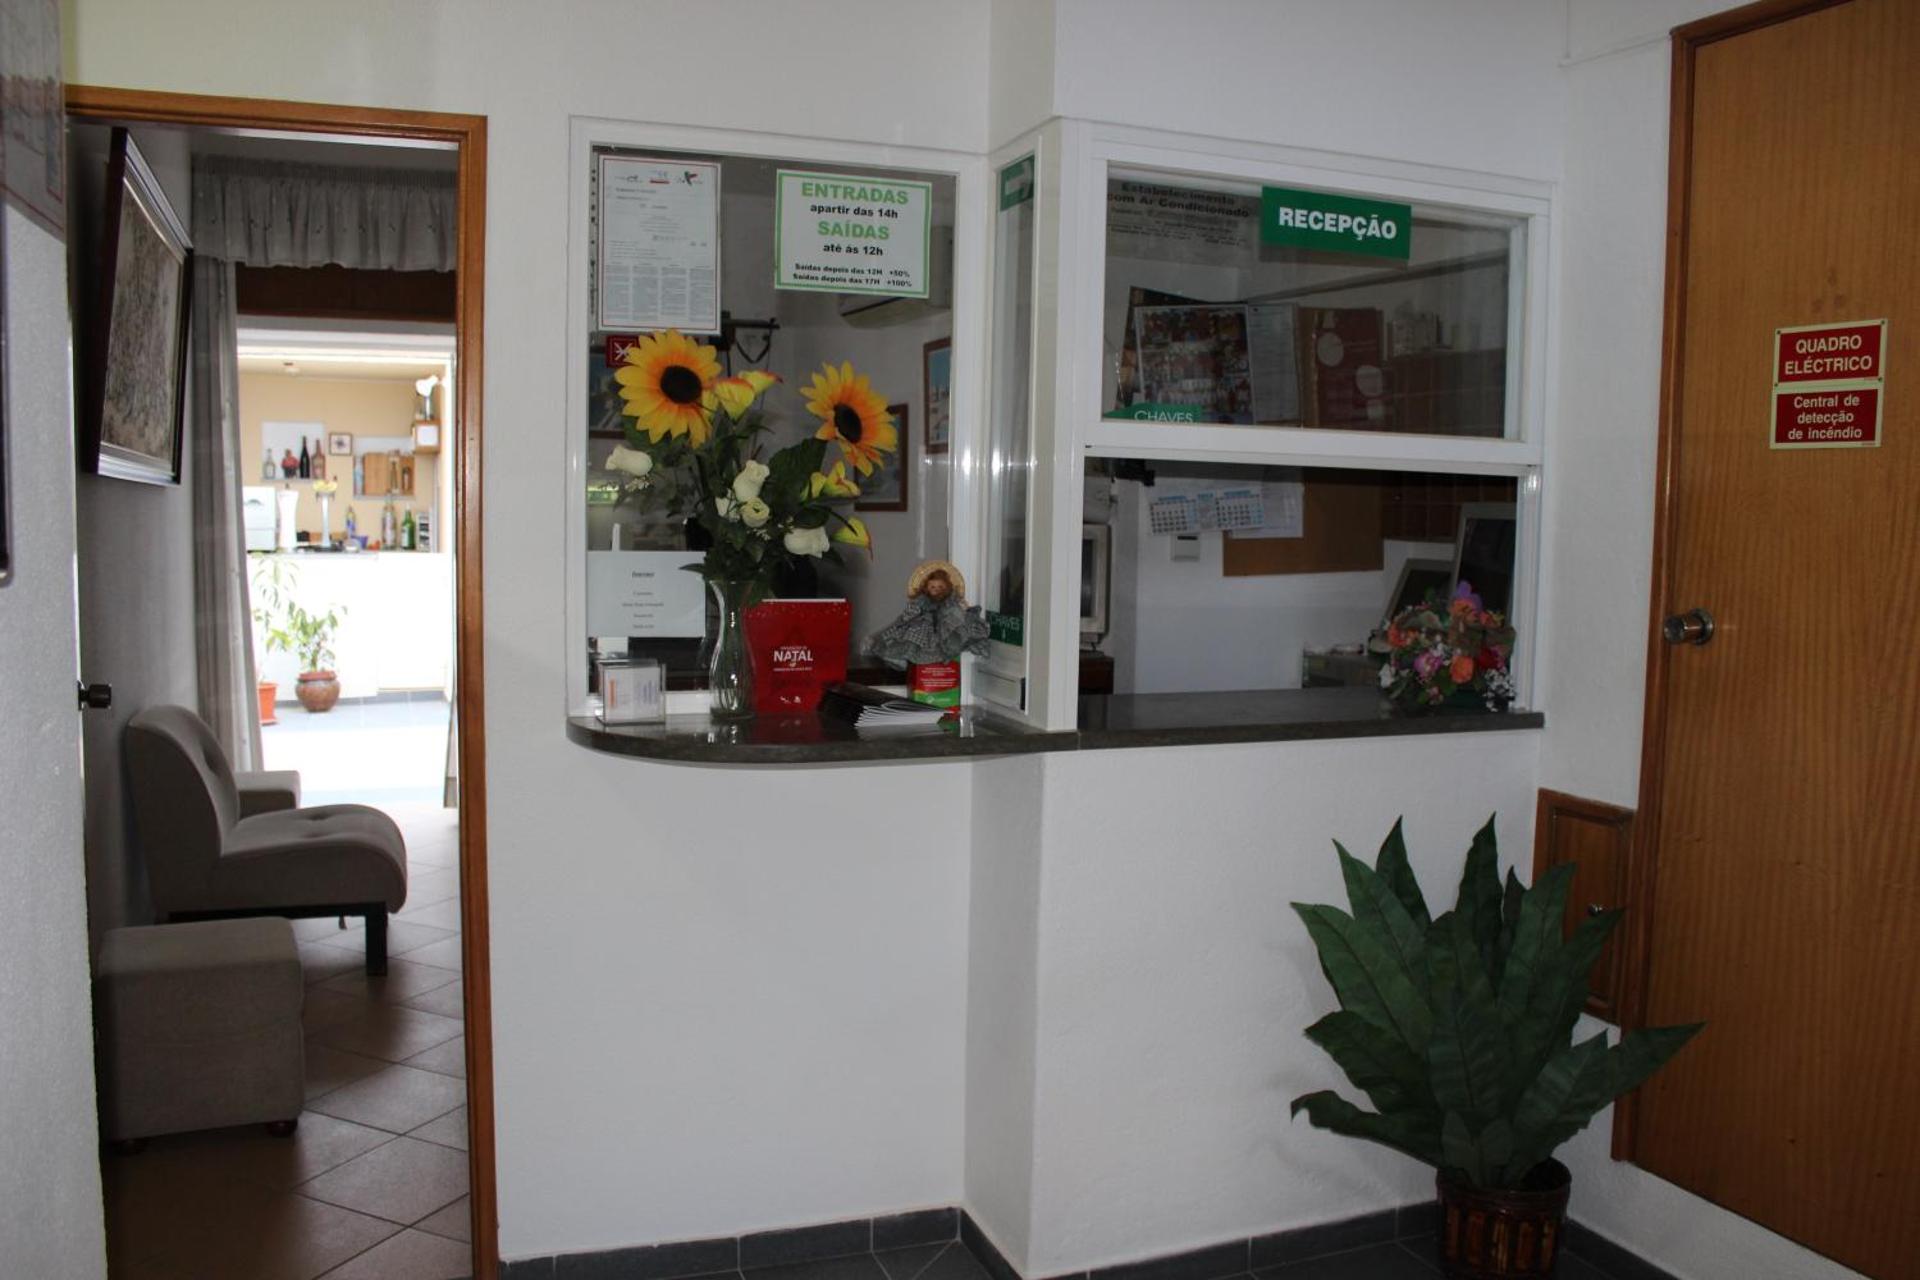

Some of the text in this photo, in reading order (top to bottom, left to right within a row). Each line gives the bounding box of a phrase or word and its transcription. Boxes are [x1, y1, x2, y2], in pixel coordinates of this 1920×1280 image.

[802, 183, 909, 205] ENTRADAS
[1121, 181, 1235, 206] Estabelecimento
[810, 203, 899, 219] apartir das 14h
[1140, 196, 1153, 206] Ar
[1158, 198, 1250, 218] Condicionado
[817, 220, 890, 240] SAÍDAS
[1279, 206, 1397, 241] RECEPÇÃO
[822, 243, 842, 254] até
[863, 246, 884, 256] 12h
[823, 265, 849, 275] depois
[851, 267, 865, 275] das
[867, 268, 883, 276] 12H
[889, 269, 911, 278] +50%
[820, 275, 847, 284] depois
[848, 277, 863, 285] das
[886, 279, 913, 288] +100%
[1795, 335, 1863, 354] QUADRO
[1785, 355, 1873, 375] ELÉCTRICO
[1794, 394, 1860, 409] Central de
[1134, 410, 1193, 424] CHAVES
[1797, 410, 1855, 425] detecção
[1788, 428, 1803, 440] de
[773, 650, 814, 662] NATAL
